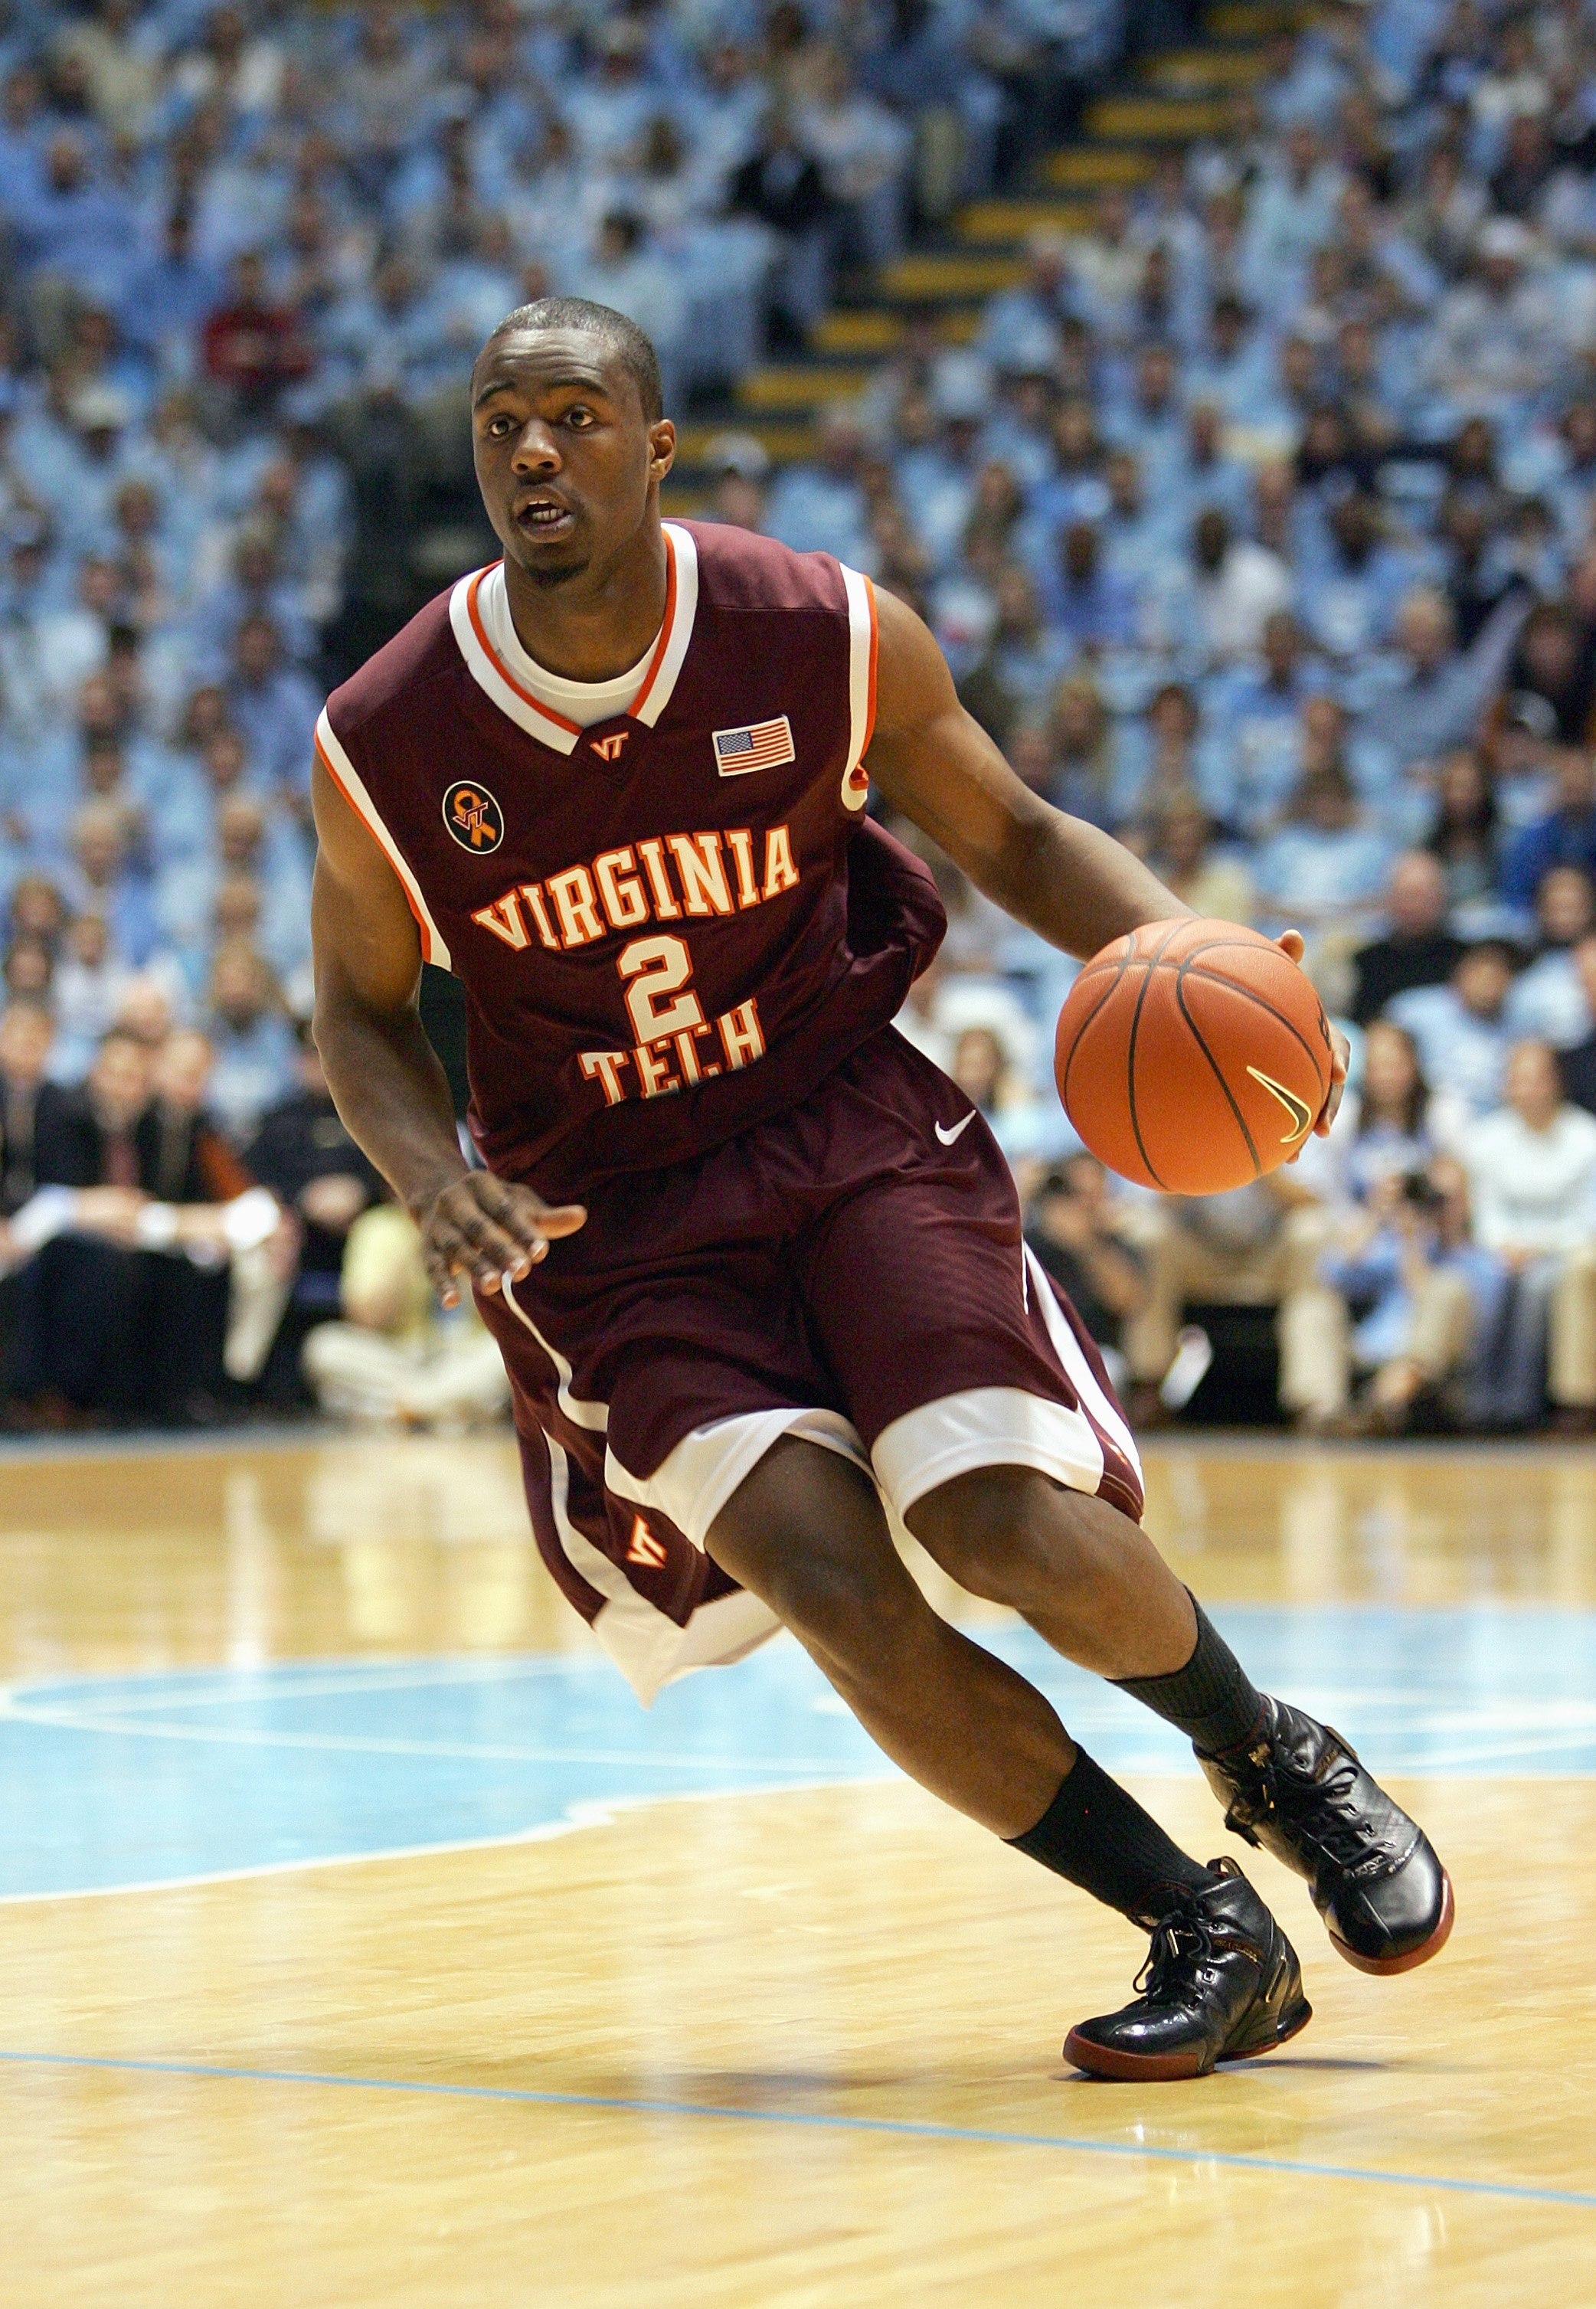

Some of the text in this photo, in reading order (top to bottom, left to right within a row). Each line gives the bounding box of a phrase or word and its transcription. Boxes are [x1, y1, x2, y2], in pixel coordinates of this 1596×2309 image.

[590, 731, 629, 761] VT
[471, 825, 800, 951] VIRGINIA
[616, 934, 706, 1047] 2
